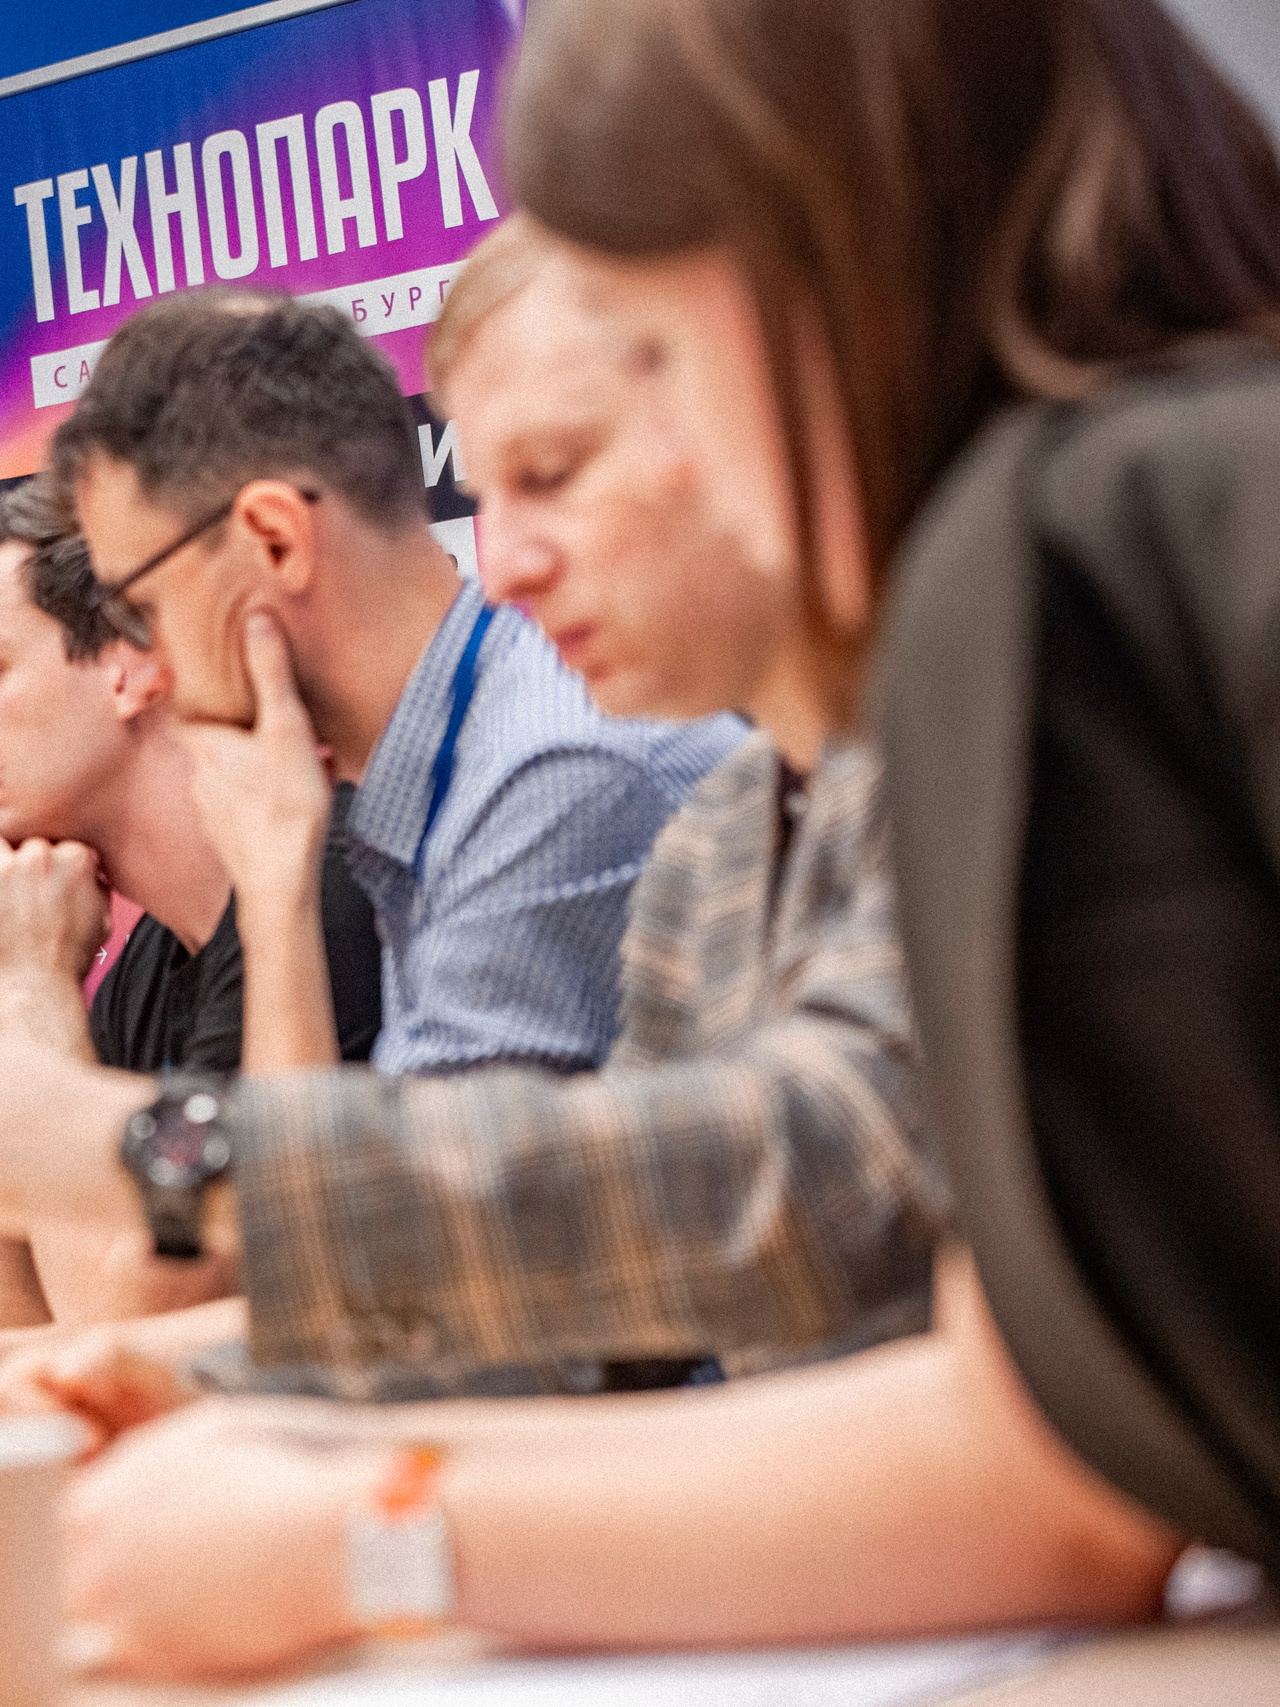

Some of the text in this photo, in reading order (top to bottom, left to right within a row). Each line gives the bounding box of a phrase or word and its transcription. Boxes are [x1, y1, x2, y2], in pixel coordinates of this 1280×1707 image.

[14, 69, 500, 323] ТЕХНОПАРК
[53, 279, 451, 389] СА БУРГ
